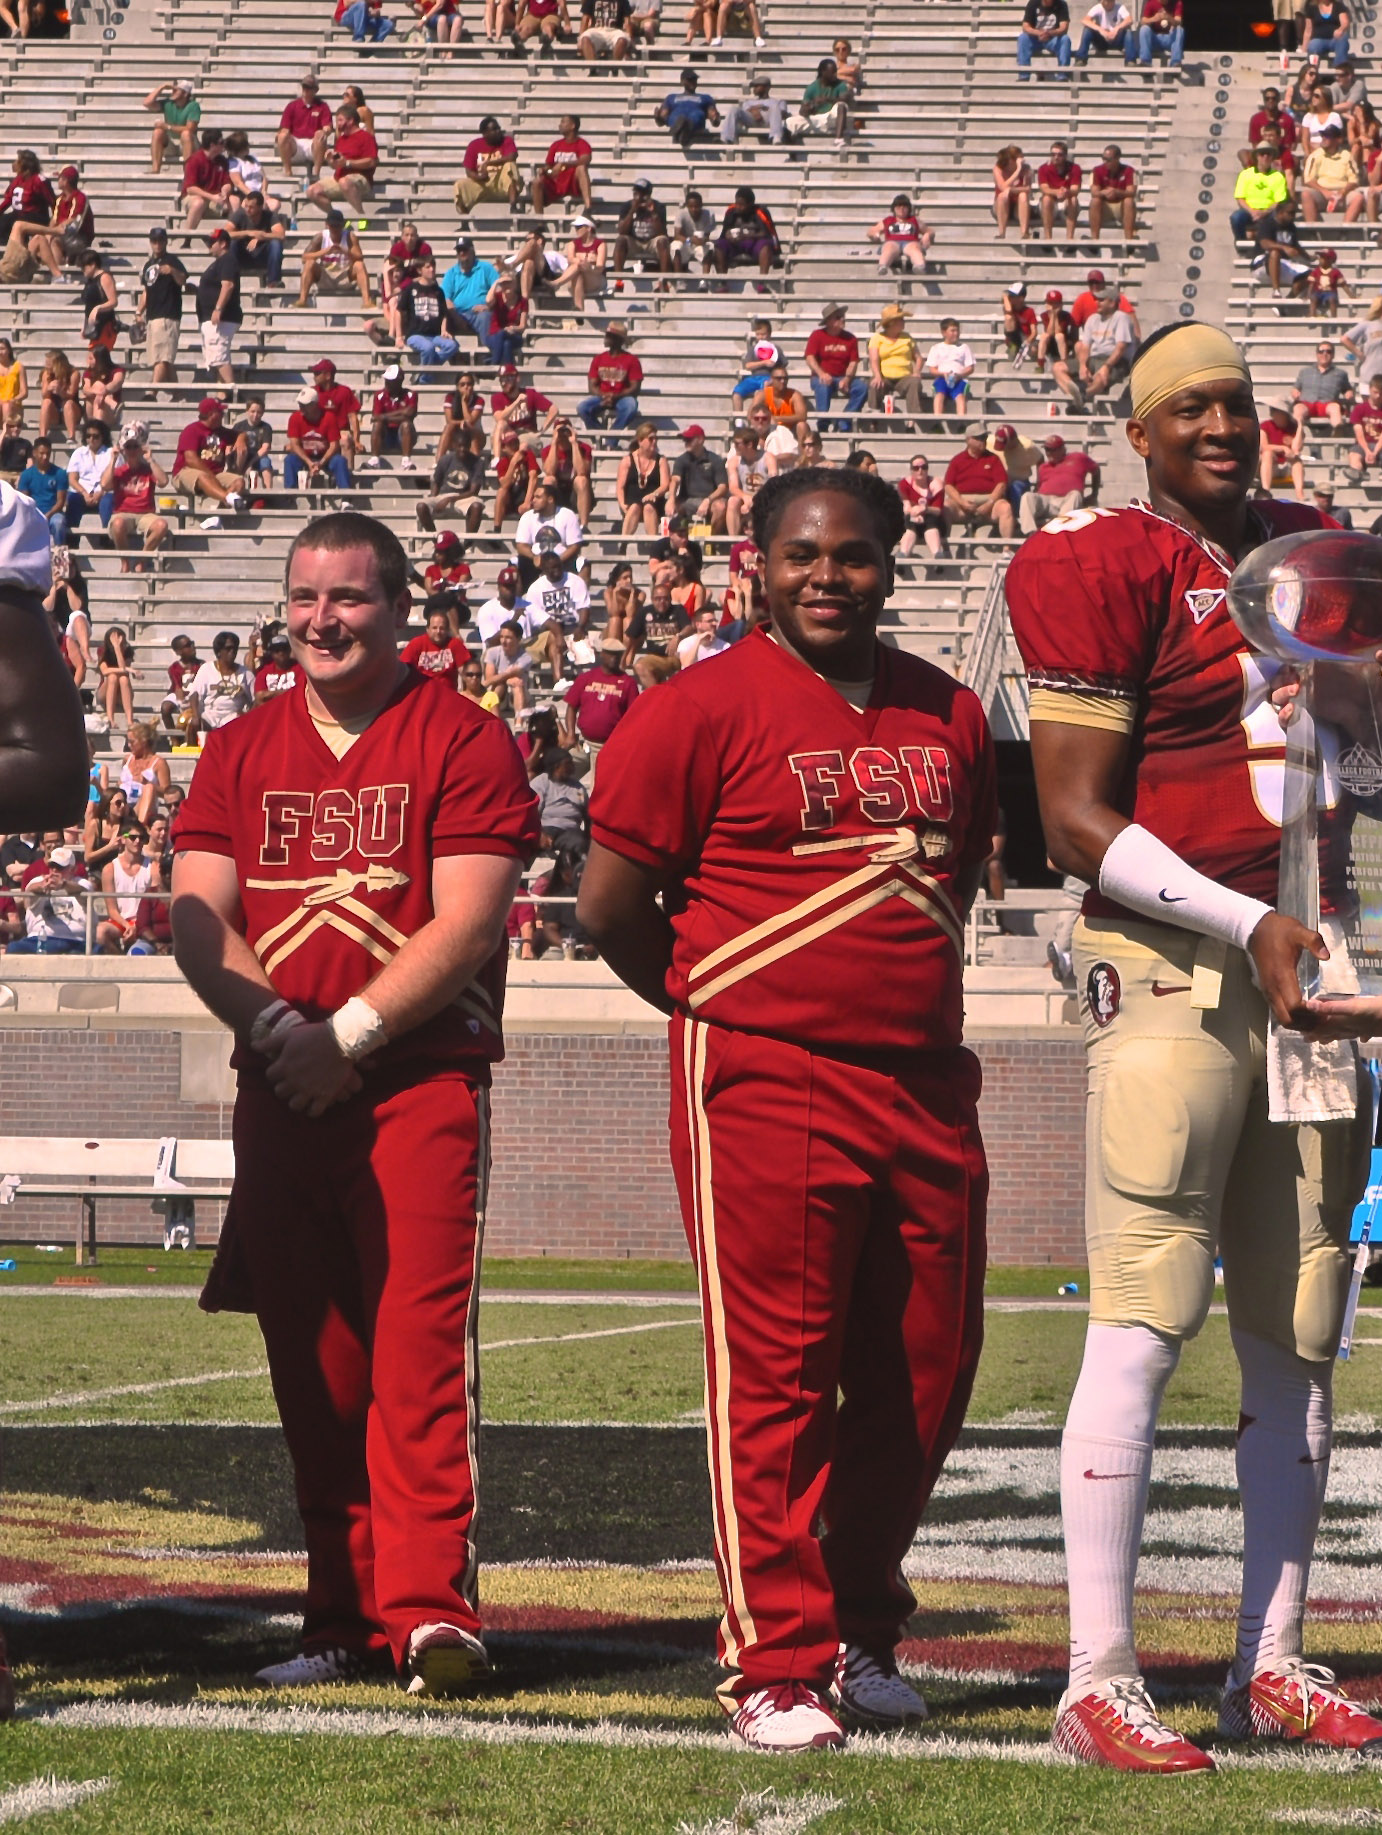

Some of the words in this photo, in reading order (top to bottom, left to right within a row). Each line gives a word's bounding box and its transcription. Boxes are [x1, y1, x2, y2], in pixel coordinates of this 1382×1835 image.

[12, 186, 24, 211] 2
[788, 746, 953, 831] FSU
[259, 784, 409, 866] FSU
[1346, 881, 1357, 890] OF
[1359, 881, 1375, 891] THE
